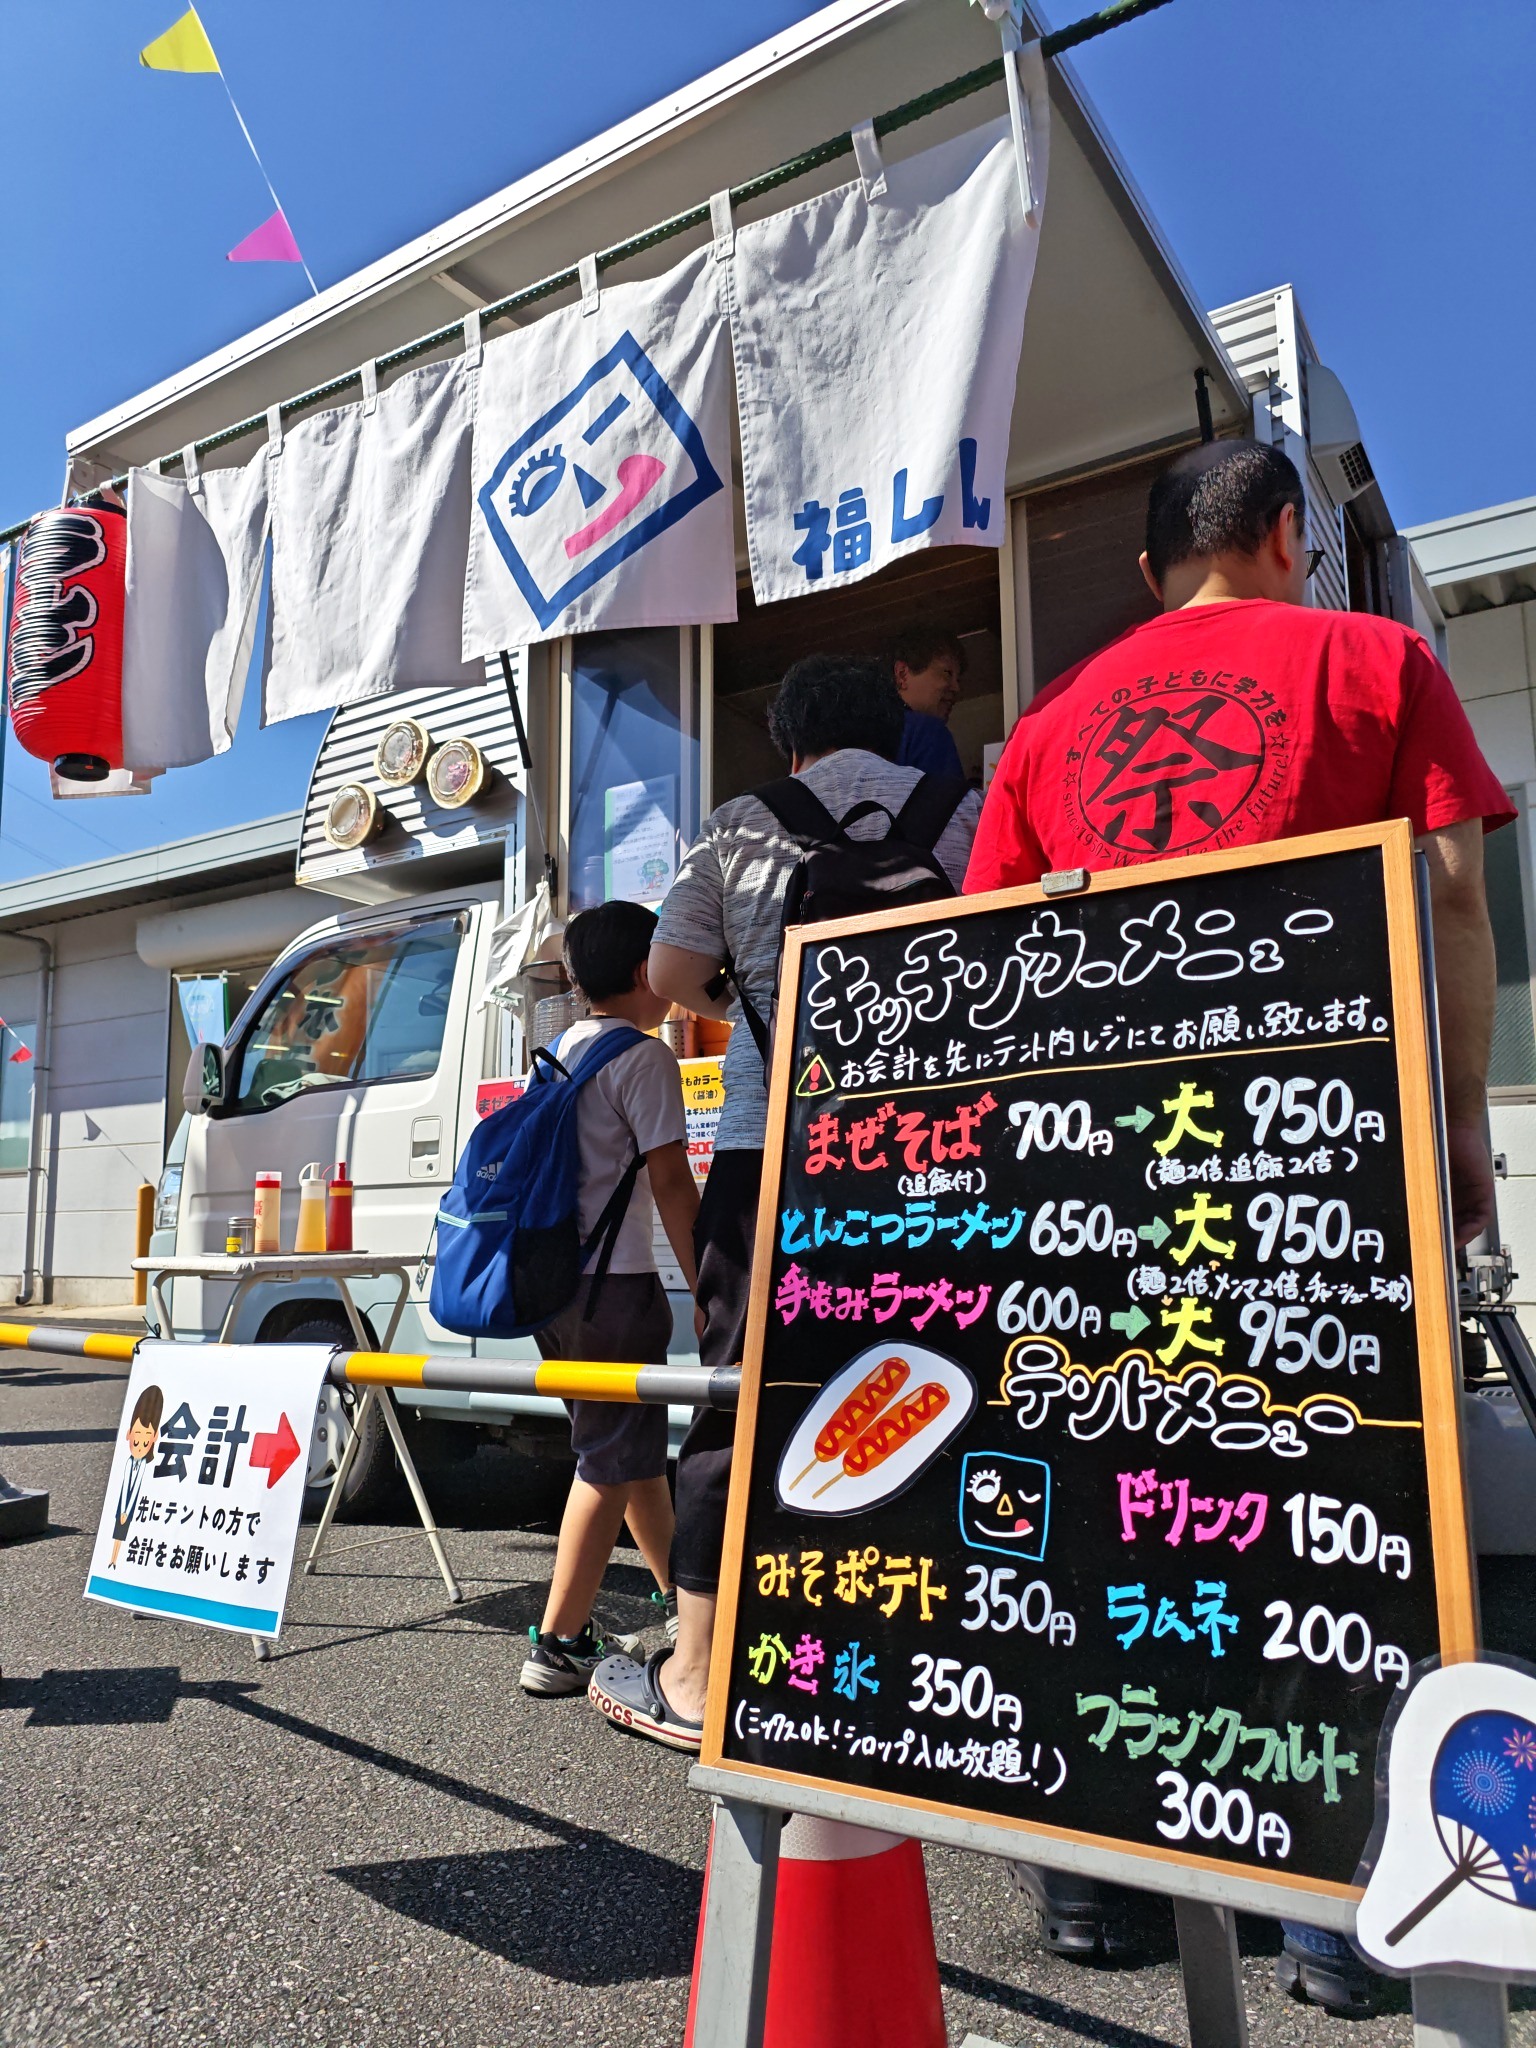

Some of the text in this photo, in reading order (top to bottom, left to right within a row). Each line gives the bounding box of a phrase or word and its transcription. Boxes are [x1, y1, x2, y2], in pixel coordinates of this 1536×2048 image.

[792, 438, 990, 579] 福しん
[1086, 695, 1263, 852] 祭
[808, 900, 1333, 1046] キッチンカーメニュー
[804, 1076, 1386, 1175] まぜそば 700円 大 950円
[780, 1192, 1385, 1265] とんこつラーメン 650円 大 950円
[775, 1263, 1381, 1375] 手もみラーメン 600円 大 950円
[153, 1402, 249, 1488] 会計
[1006, 1342, 1356, 1458] テントメニュー
[126, 1536, 274, 1584] 会計をお願いします
[136, 1496, 260, 1536] 先にテントの方で
[1117, 1468, 1411, 1580] ドリンク 150円
[755, 1545, 1077, 1647] みそポテト 350円
[1107, 1580, 1411, 1690] ラムネ 200円
[748, 1632, 1023, 1733] かき氷 350円
[1076, 1684, 1359, 1803] フランクフルト
[1155, 1770, 1291, 1859] 300円
